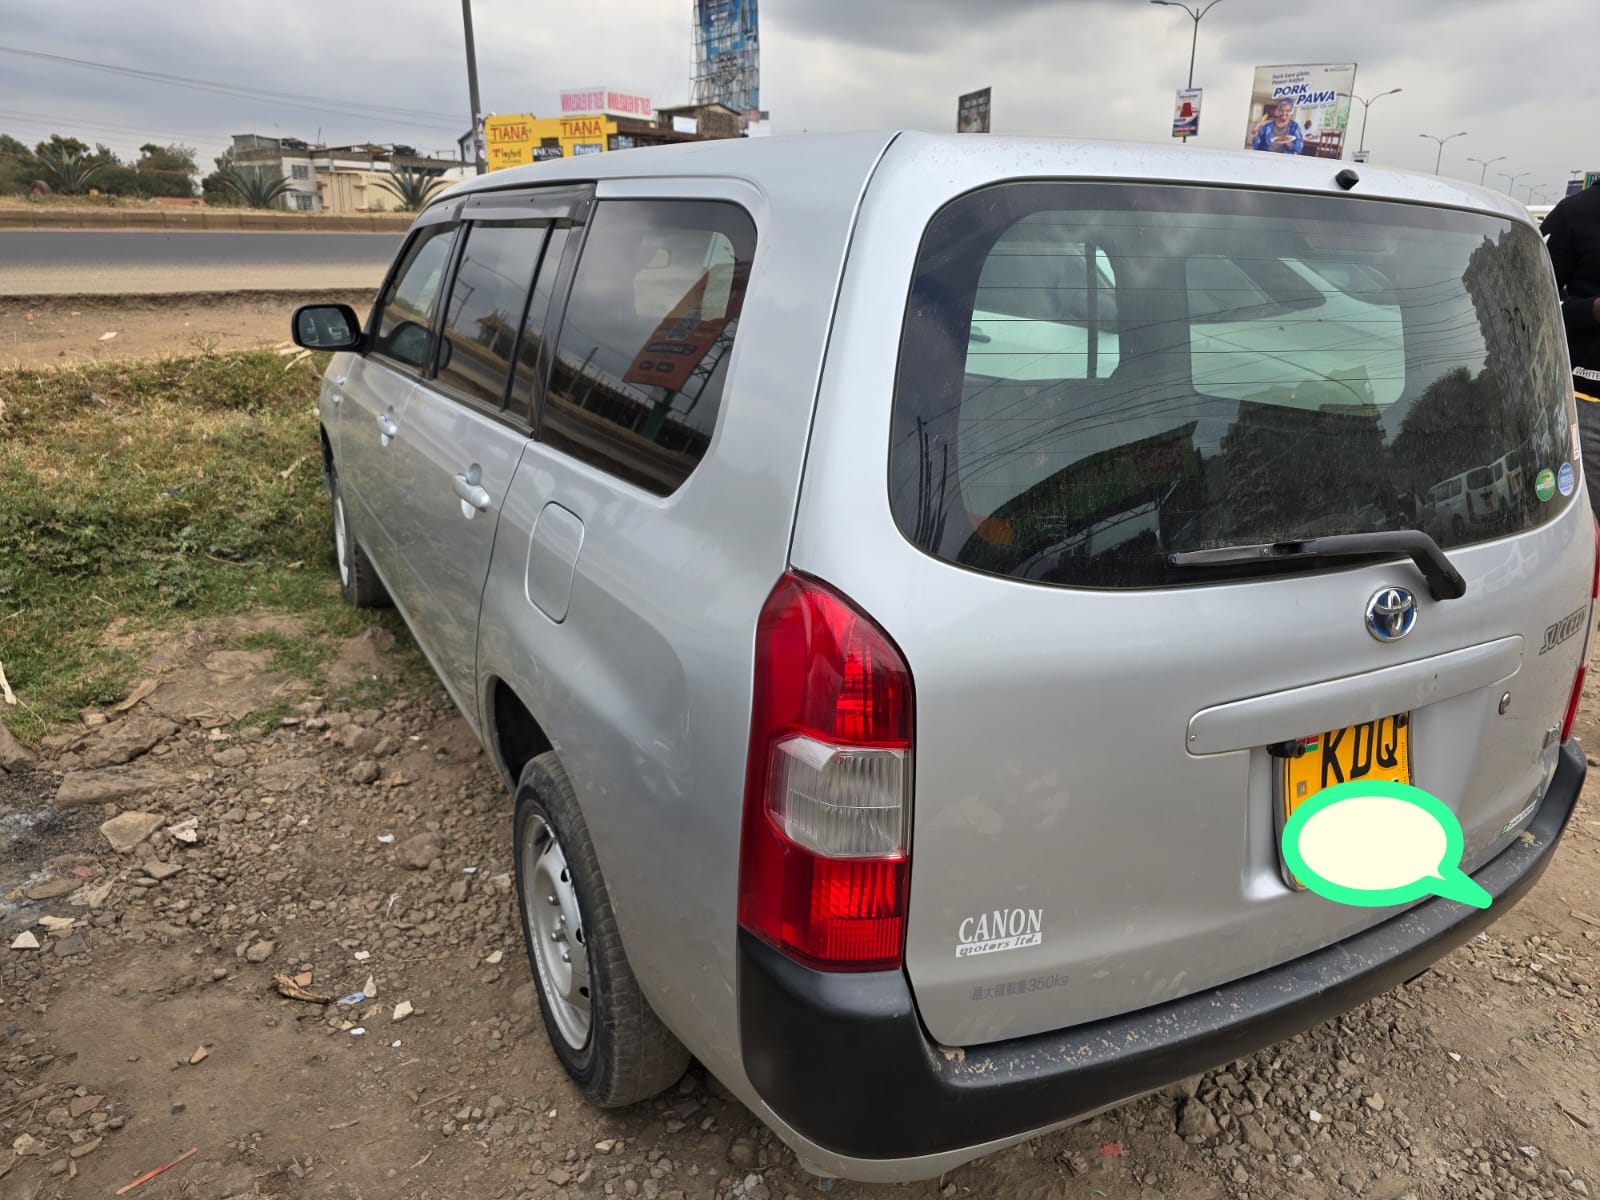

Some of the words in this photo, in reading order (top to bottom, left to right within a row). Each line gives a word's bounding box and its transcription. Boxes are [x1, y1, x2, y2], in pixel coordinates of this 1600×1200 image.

[1273, 83, 1310, 98] PORK
[1296, 91, 1335, 105] PAWA
[490, 125, 529, 141] TIANA
[560, 120, 602, 137] TIANA
[1321, 714, 1399, 789] KDQ
[958, 908, 1043, 944] CANON
[959, 940, 1010, 956] motors
